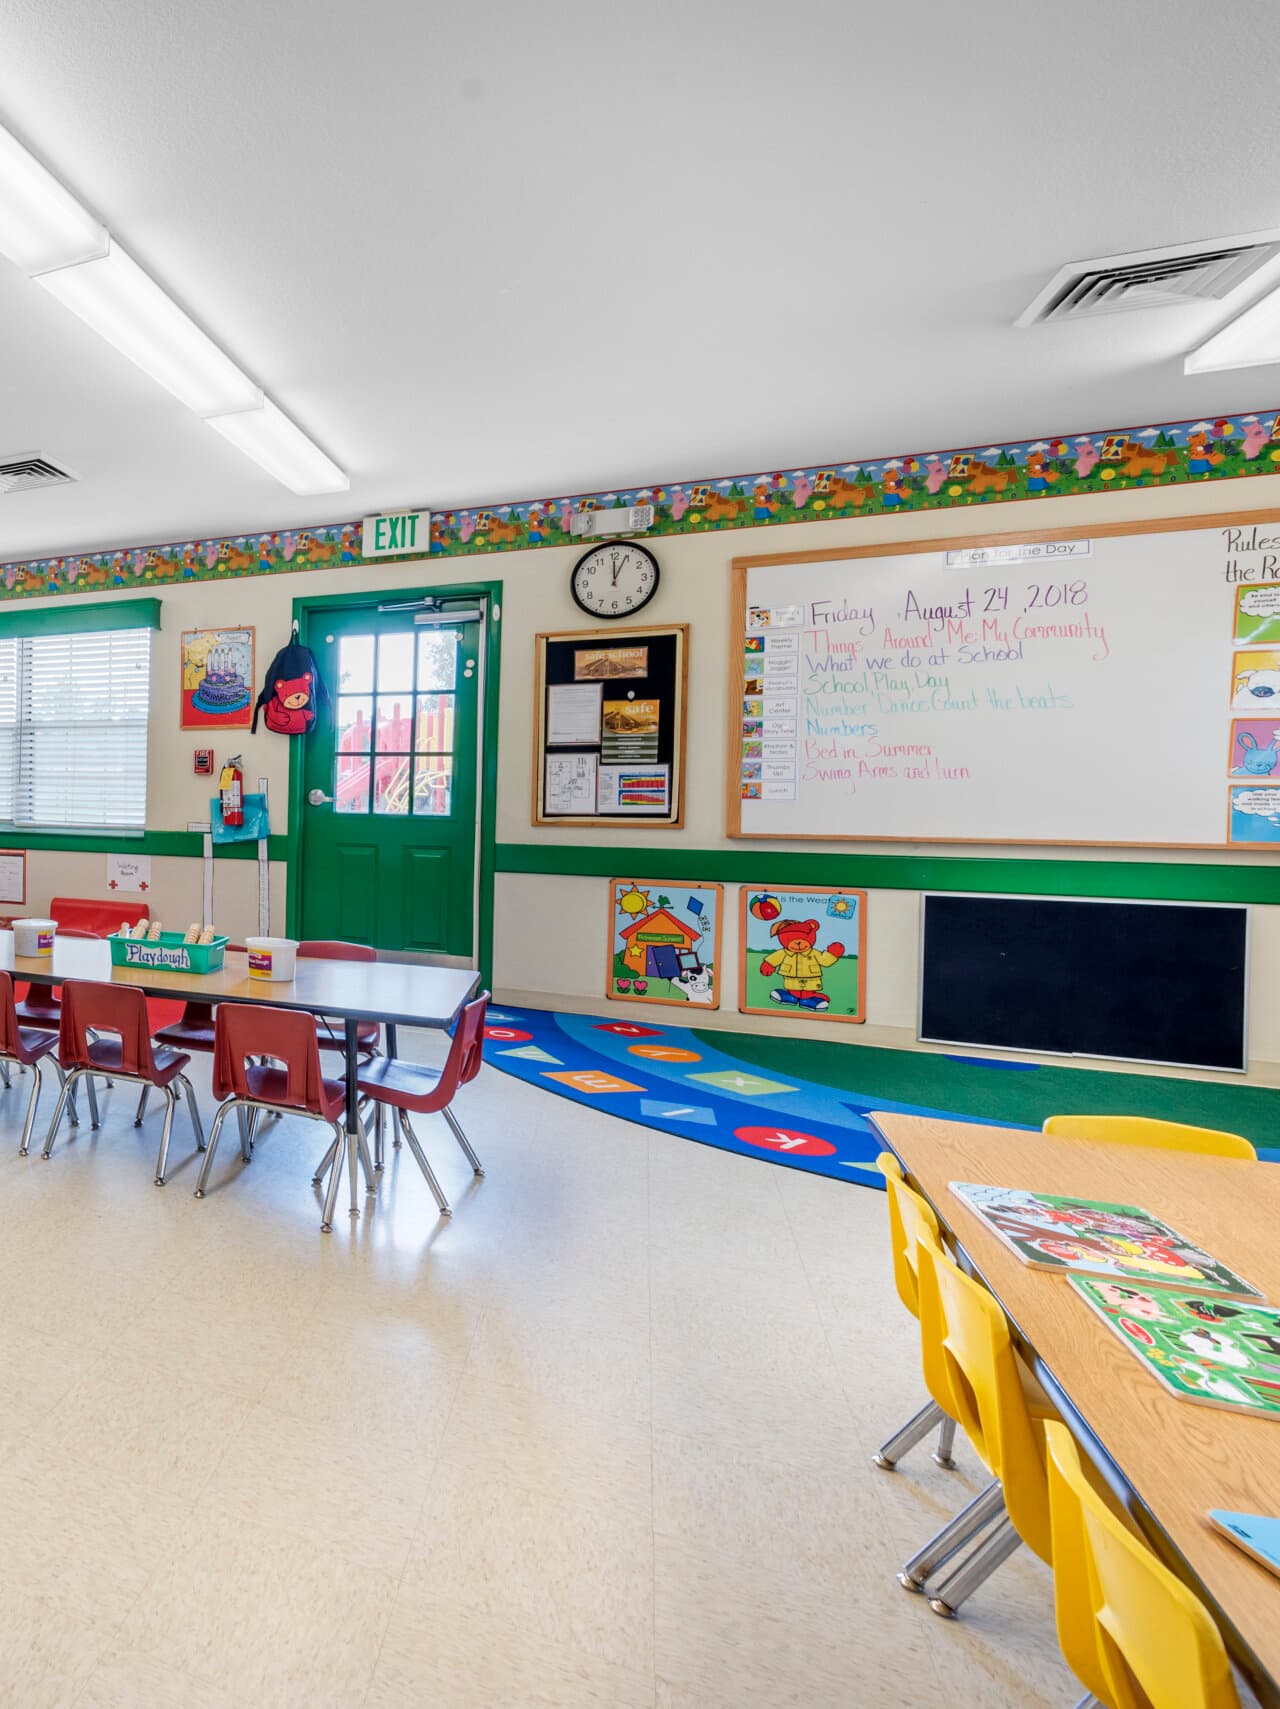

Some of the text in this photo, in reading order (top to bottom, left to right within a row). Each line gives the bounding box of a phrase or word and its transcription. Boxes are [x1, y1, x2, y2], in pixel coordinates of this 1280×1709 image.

[375, 514, 419, 550] EXIT
[1222, 527, 1280, 552] Rules
[610, 552, 620, 560] 12
[1046, 544, 1075, 554] Day
[587, 566, 596, 574] 10
[596, 558, 604, 566] 11
[636, 561, 643, 569] 2
[641, 573, 648, 581] 3
[1223, 560, 1255, 583] the
[582, 580, 589, 588] 9
[611, 601, 618, 609] 6
[626, 596, 632, 604] 5
[811, 599, 875, 636] Friday
[984, 586, 1009, 613] 24
[804, 630, 863, 661] Things
[883, 619, 934, 649] Around
[983, 618, 1012, 650] My
[1013, 612, 1110, 661] Community
[806, 653, 855, 672] What
[866, 655, 895, 669] we
[901, 650, 921, 667] do
[928, 648, 950, 665] at
[958, 640, 1023, 664] School
[915, 671, 950, 699] Day
[626, 702, 654, 714] safe
[805, 695, 867, 717] Number
[987, 687, 1011, 710] the
[1016, 682, 1075, 709] beats
[806, 719, 879, 737] Numbers
[805, 736, 933, 760] Bed in Summer
[802, 760, 856, 793] Swing
[858, 760, 898, 778] Arms
[904, 758, 930, 780] and
